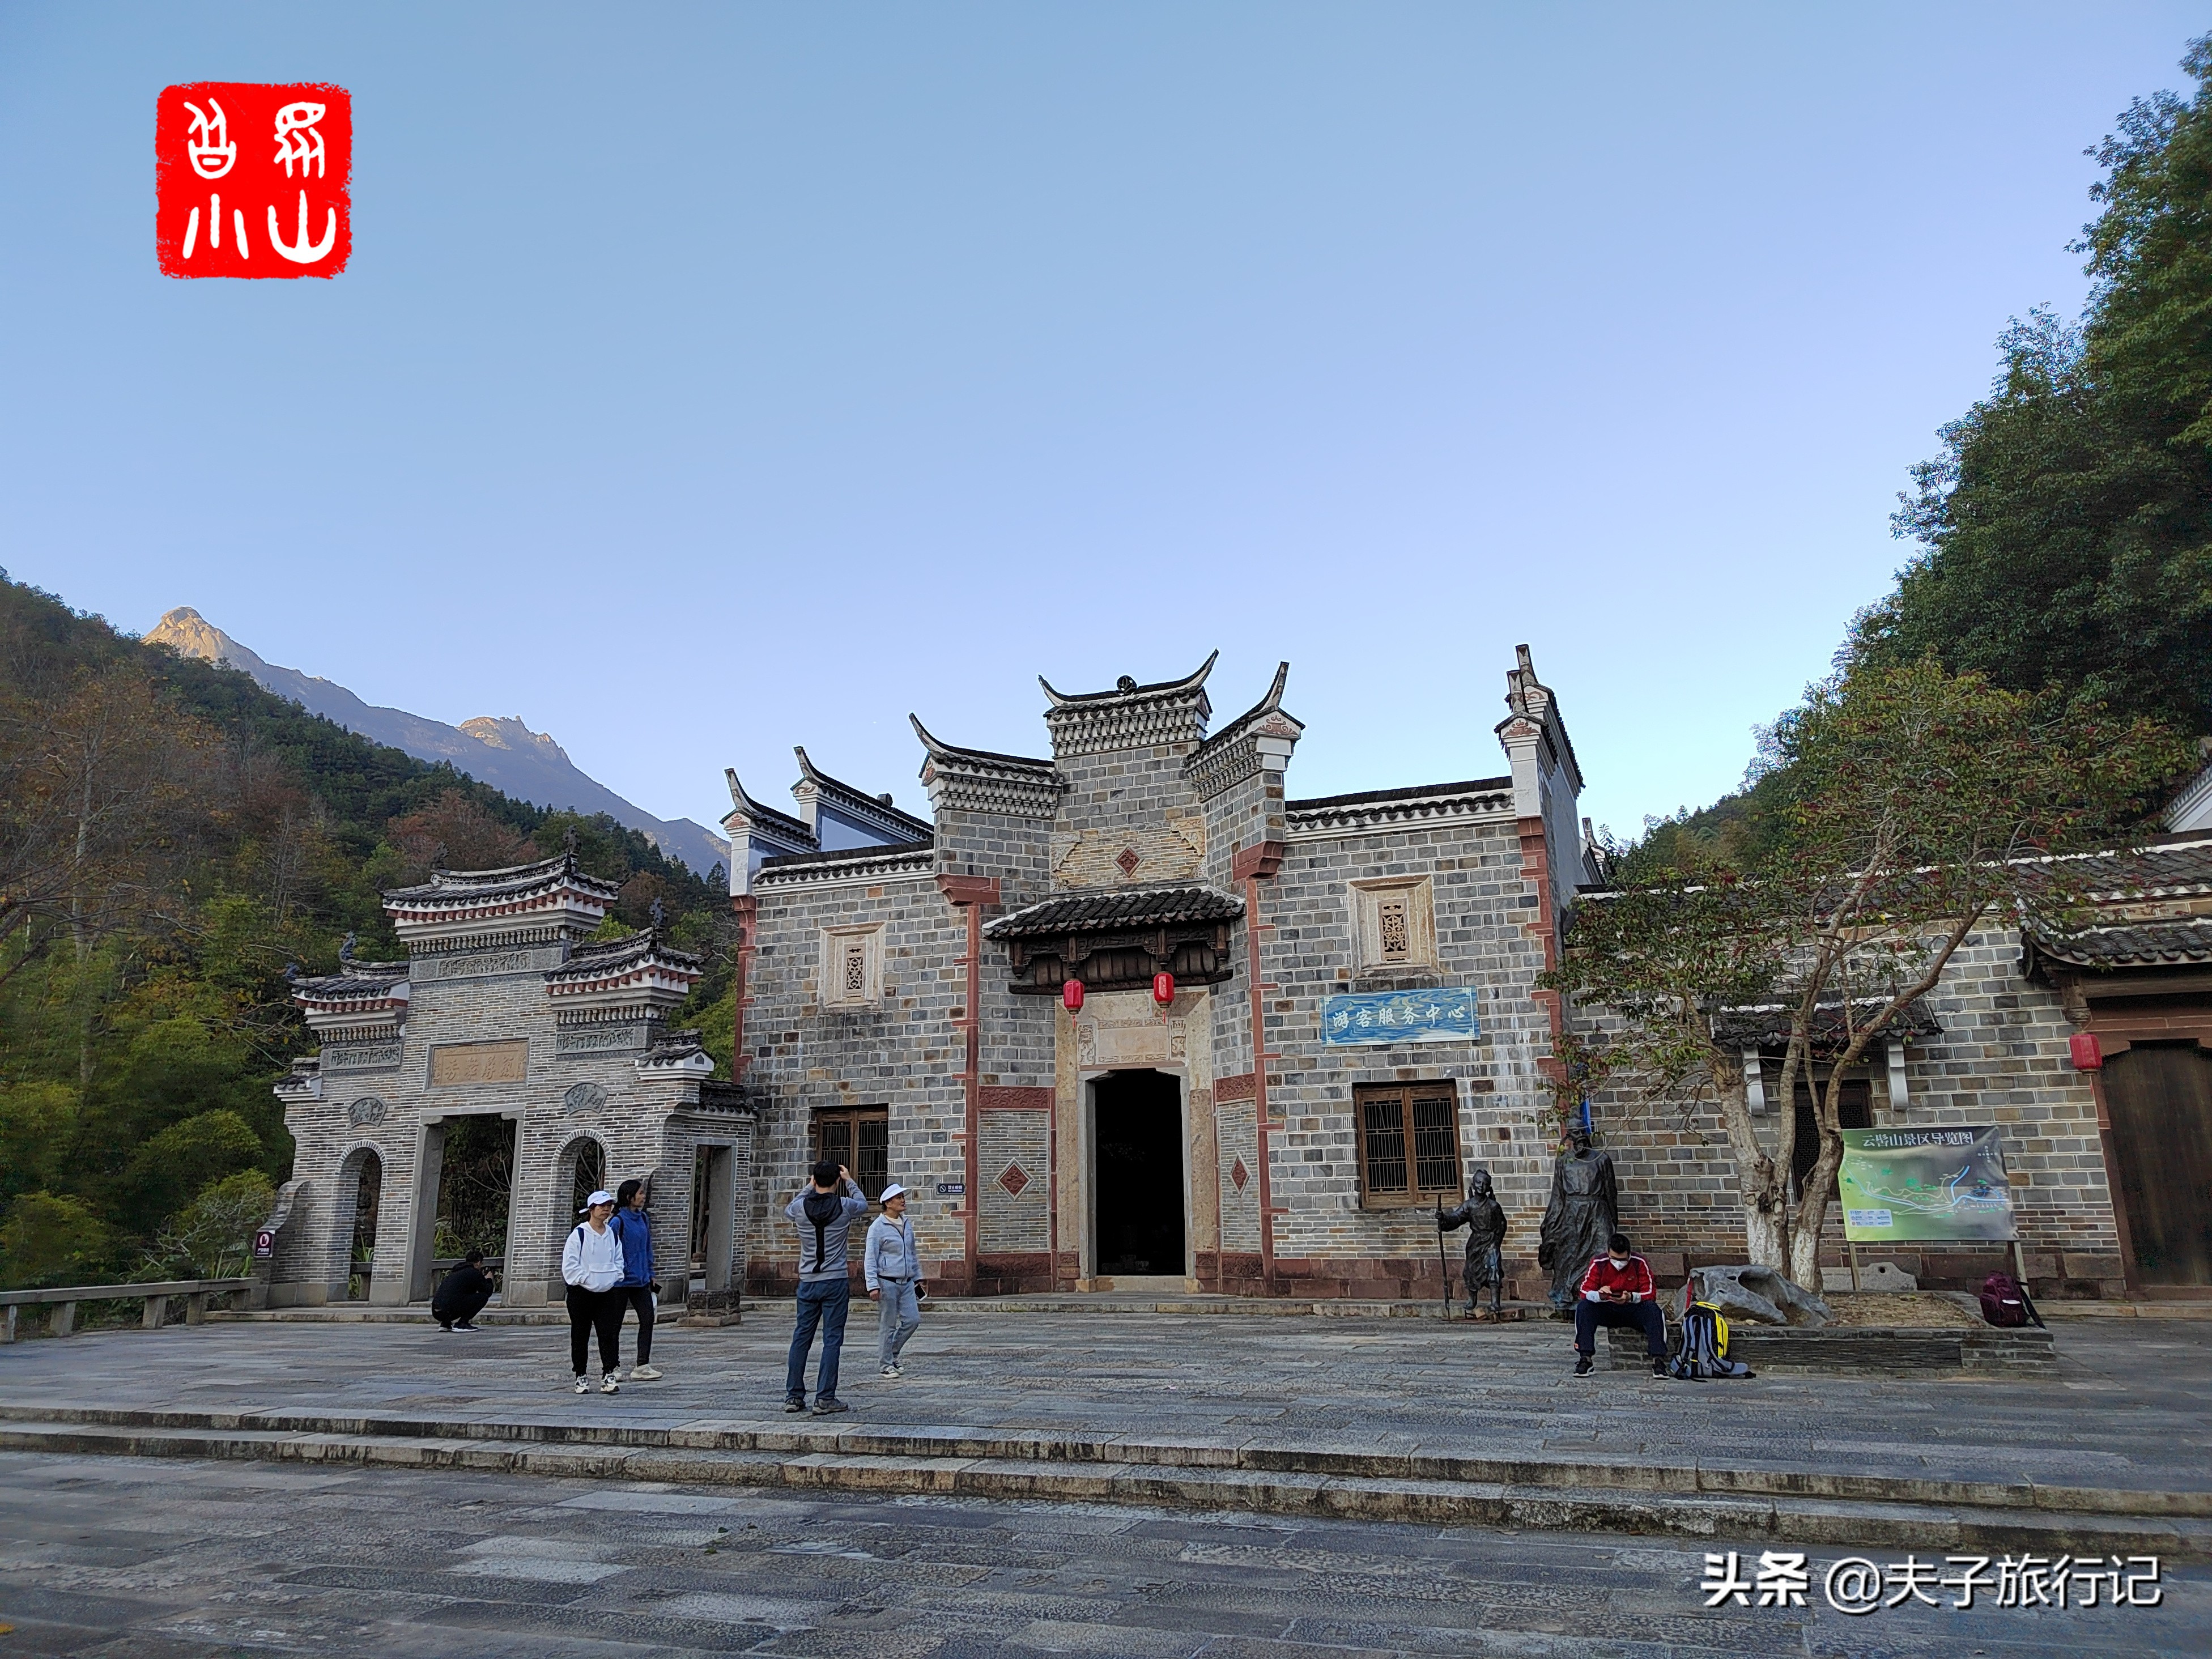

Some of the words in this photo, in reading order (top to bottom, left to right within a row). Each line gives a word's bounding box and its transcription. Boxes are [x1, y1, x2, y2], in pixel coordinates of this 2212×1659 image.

[1332, 1003, 1466, 1028] 游客服务中心
[1862, 1131, 1974, 1147] 云髻山景区导览图
